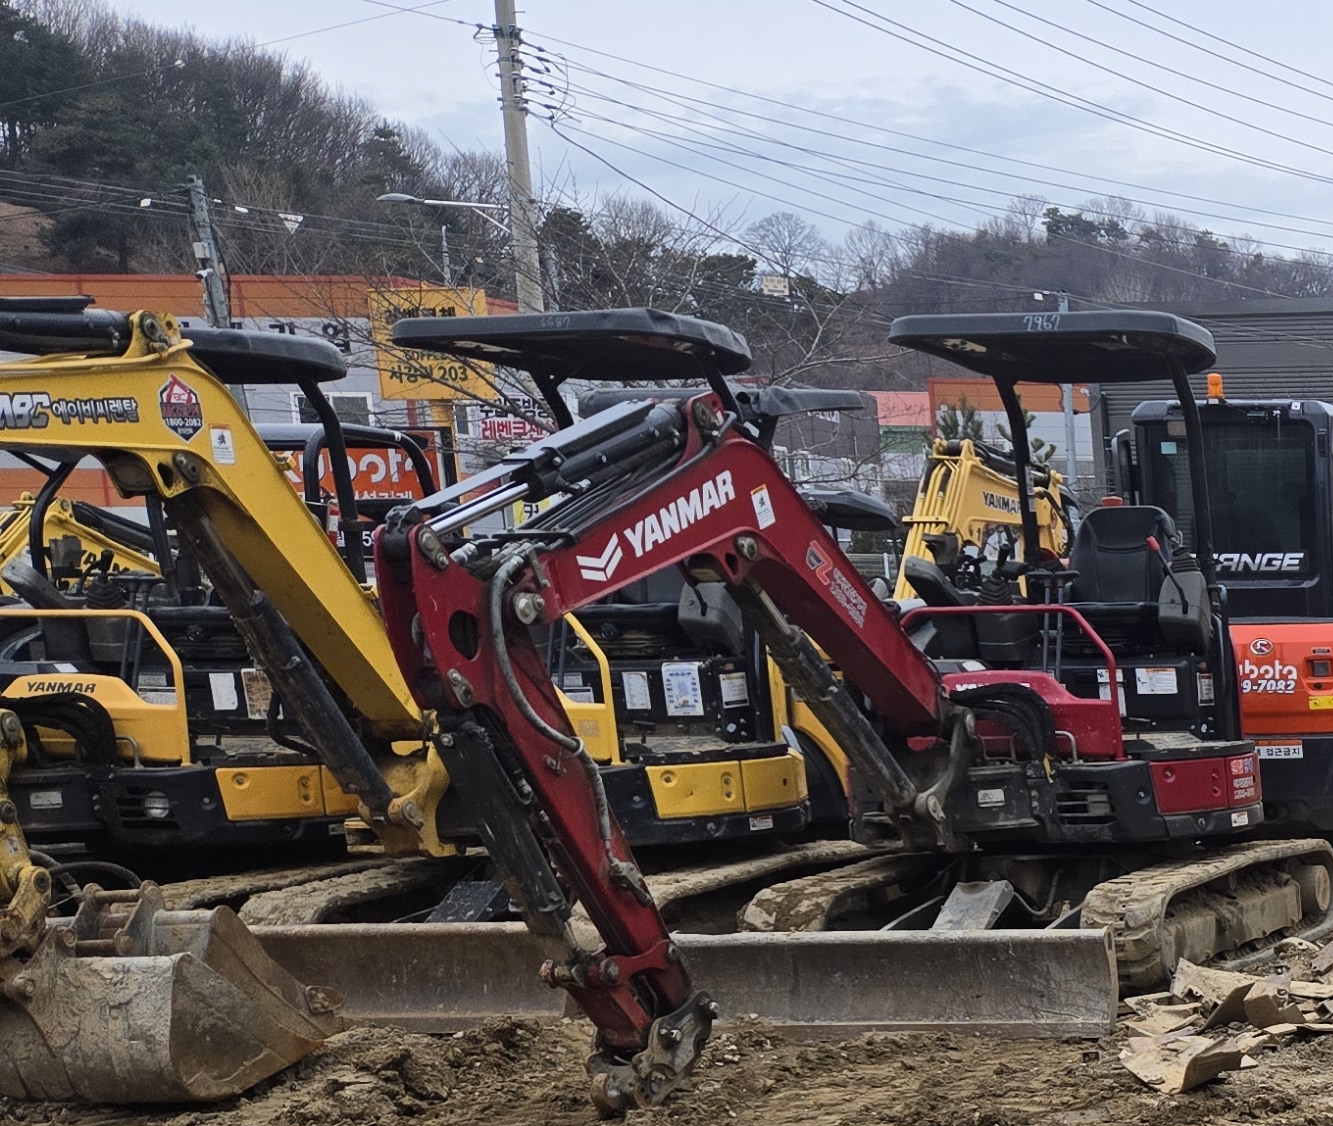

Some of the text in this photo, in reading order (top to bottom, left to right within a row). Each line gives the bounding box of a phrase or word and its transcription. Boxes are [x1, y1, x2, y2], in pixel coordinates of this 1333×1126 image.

[1023, 314, 1061, 332] 7967
[437, 365, 468, 381] 203
[51, 397, 139, 424] 에이비씨렌탈
[623, 469, 736, 558] YANMAR
[27, 681, 97, 693] YANMAR
[1265, 747, 1300, 757] 접근금지
